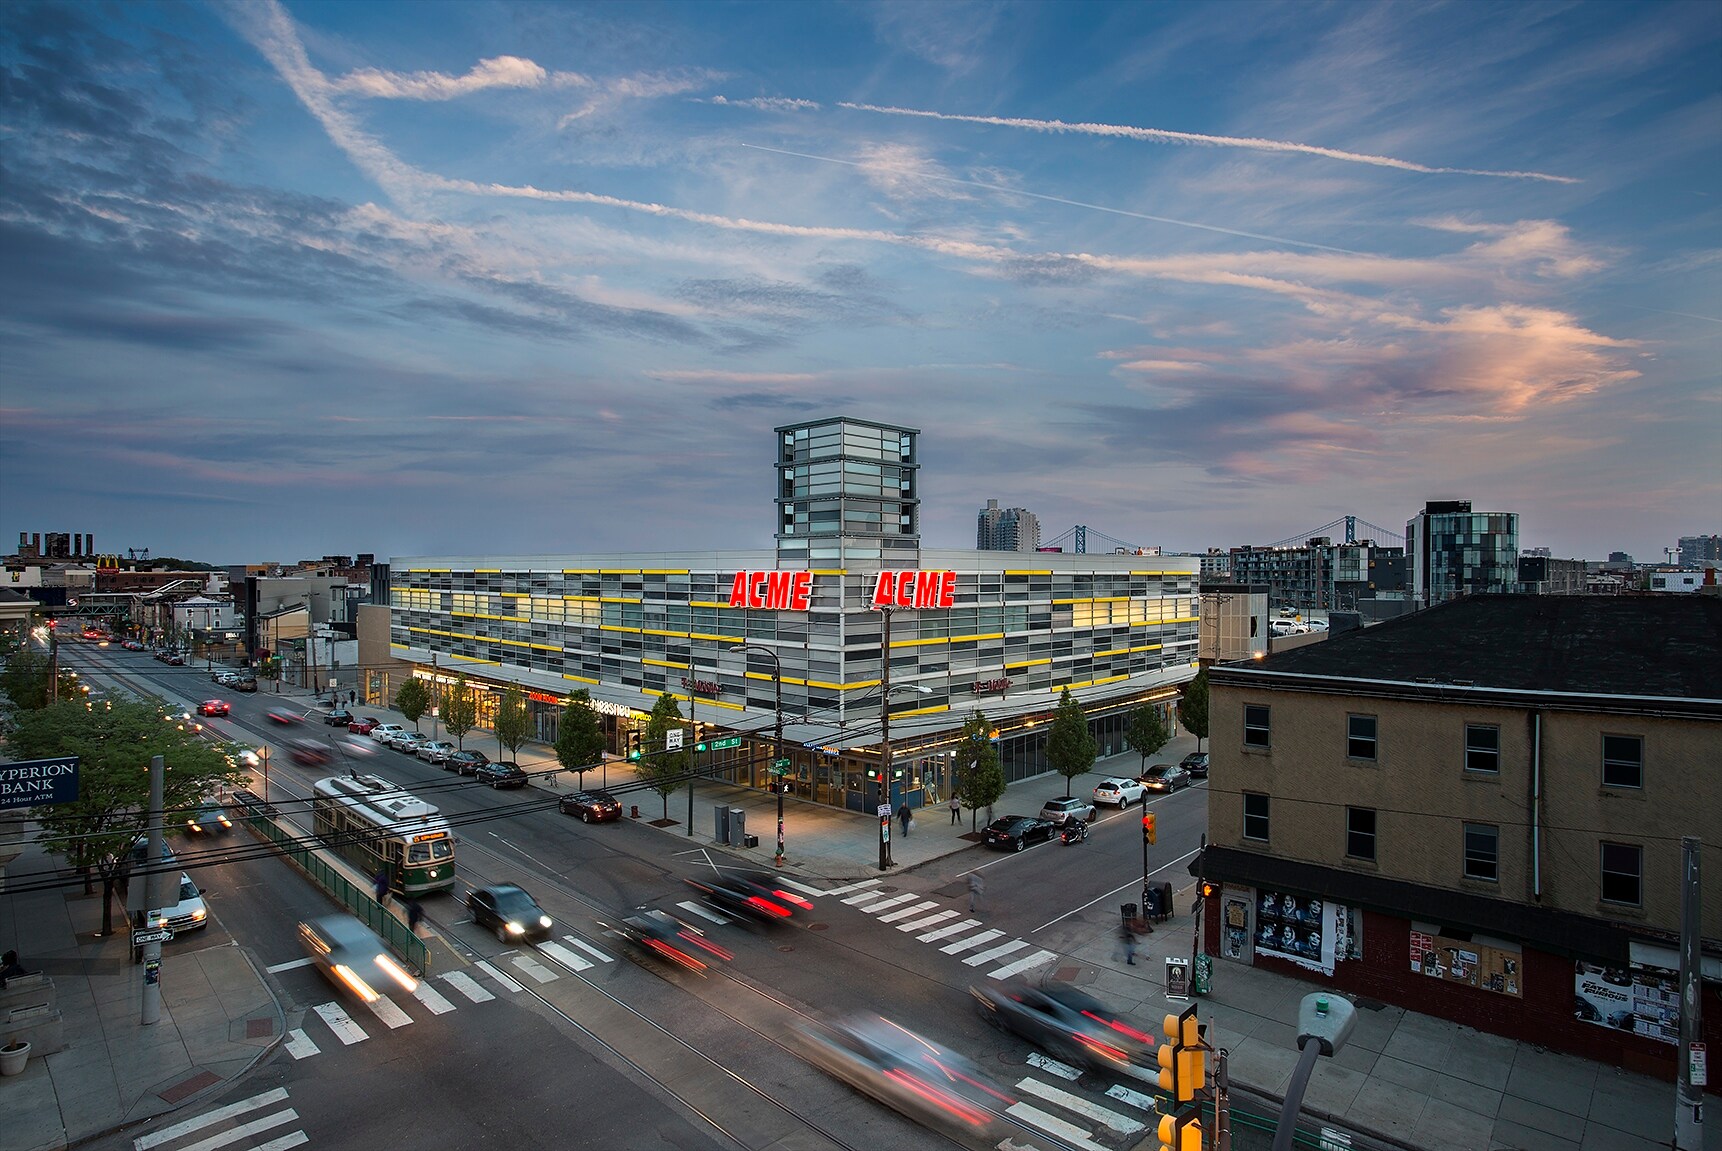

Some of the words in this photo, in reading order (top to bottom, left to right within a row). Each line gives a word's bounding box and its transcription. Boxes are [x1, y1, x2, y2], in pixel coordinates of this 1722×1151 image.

[729, 571, 814, 610] ACME
[871, 571, 957, 610] ACME
[715, 740, 727, 748] 2nd
[1, 778, 54, 795] BANK
[34, 793, 53, 801] ATM
[150, 933, 162, 941] WAY
[1582, 983, 1609, 993] FATE
[1584, 988, 1629, 1002] FURIOUS
